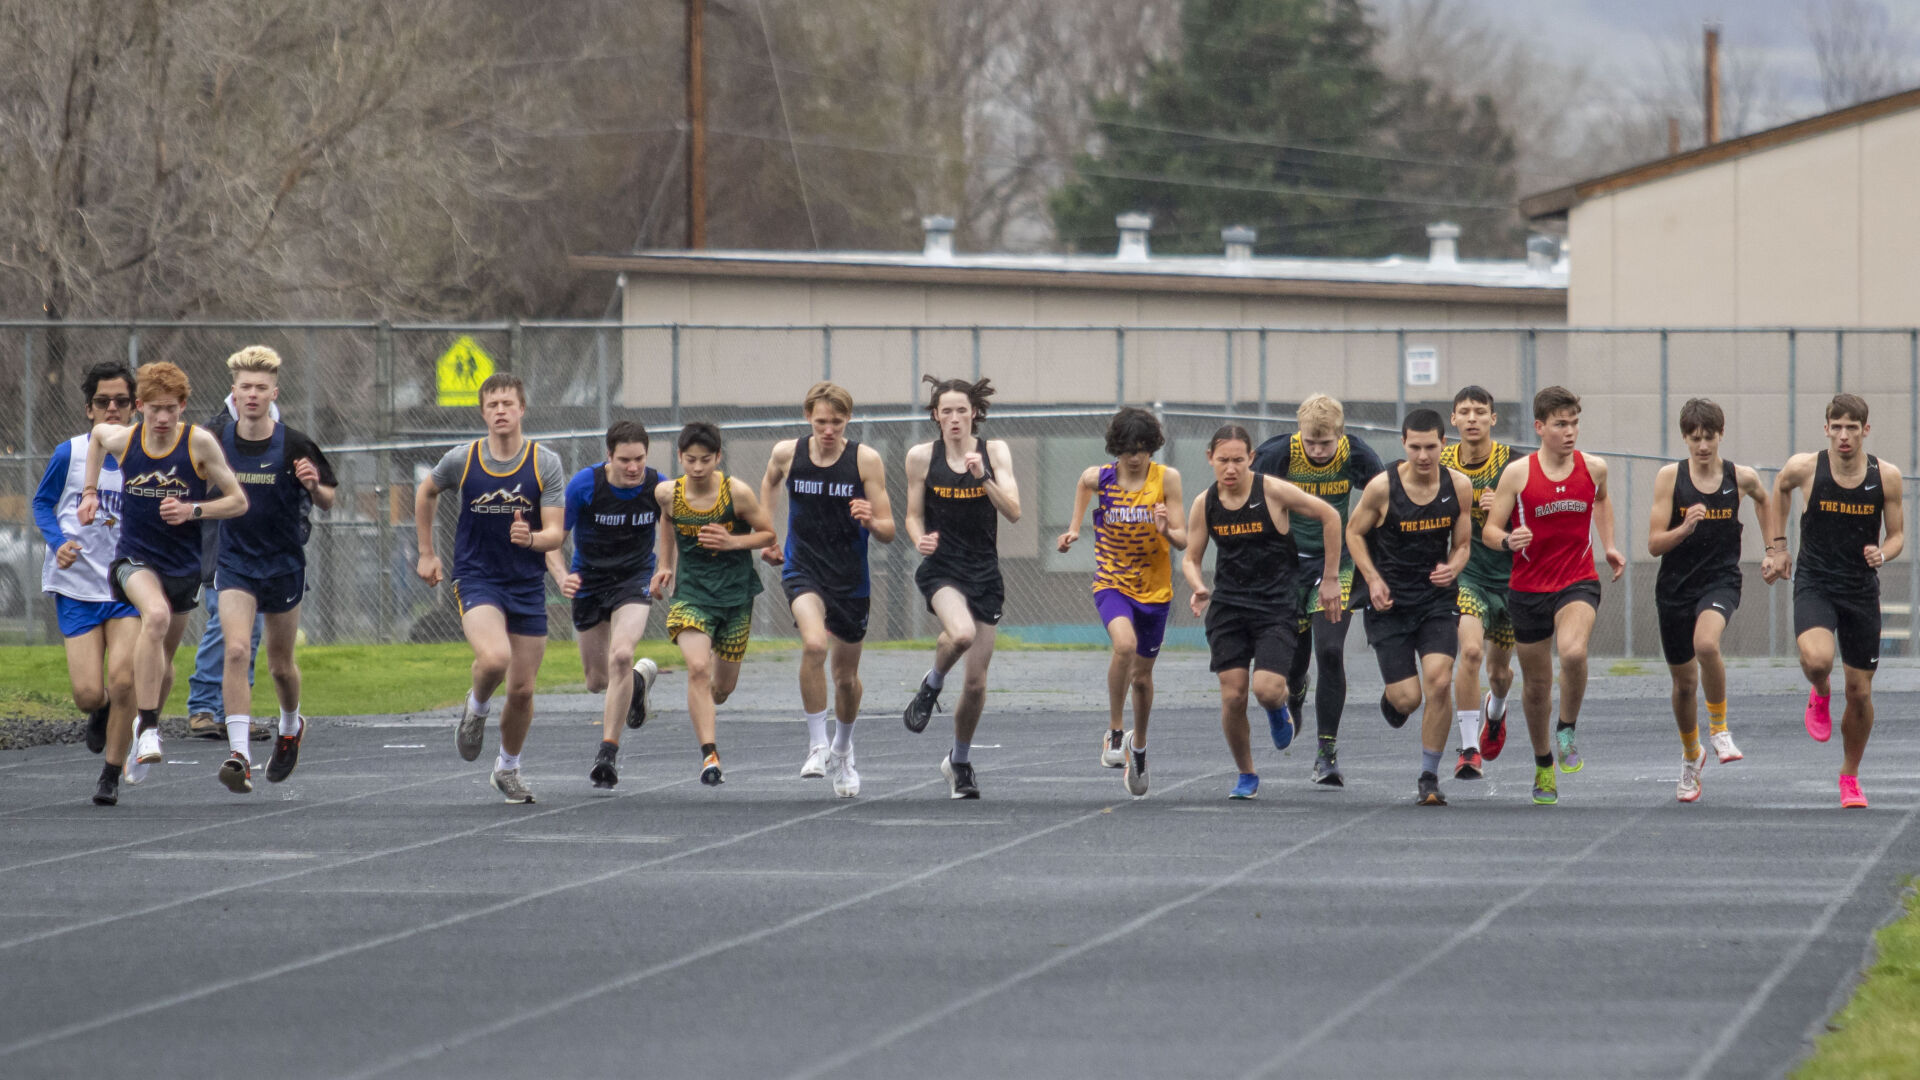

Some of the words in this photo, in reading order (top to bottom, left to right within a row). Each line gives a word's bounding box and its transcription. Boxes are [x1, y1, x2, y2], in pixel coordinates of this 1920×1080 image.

[126, 485, 190, 497] JOSEPH
[794, 480, 823, 494] TROUT
[829, 482, 854, 497] LAKE
[933, 486, 952, 498] THE
[1319, 480, 1349, 496] WASCO
[470, 505, 533, 514] JOSEPH
[1704, 508, 1732, 520] ALLES
[1819, 501, 1838, 512] THE
[1840, 502, 1875, 515] DALLES
[594, 513, 626, 526] TROUT
[632, 511, 655, 526] LAKE
[1400, 521, 1418, 532] THE
[1419, 516, 1451, 531] DALLES
[1230, 522, 1263, 535] DALLES
